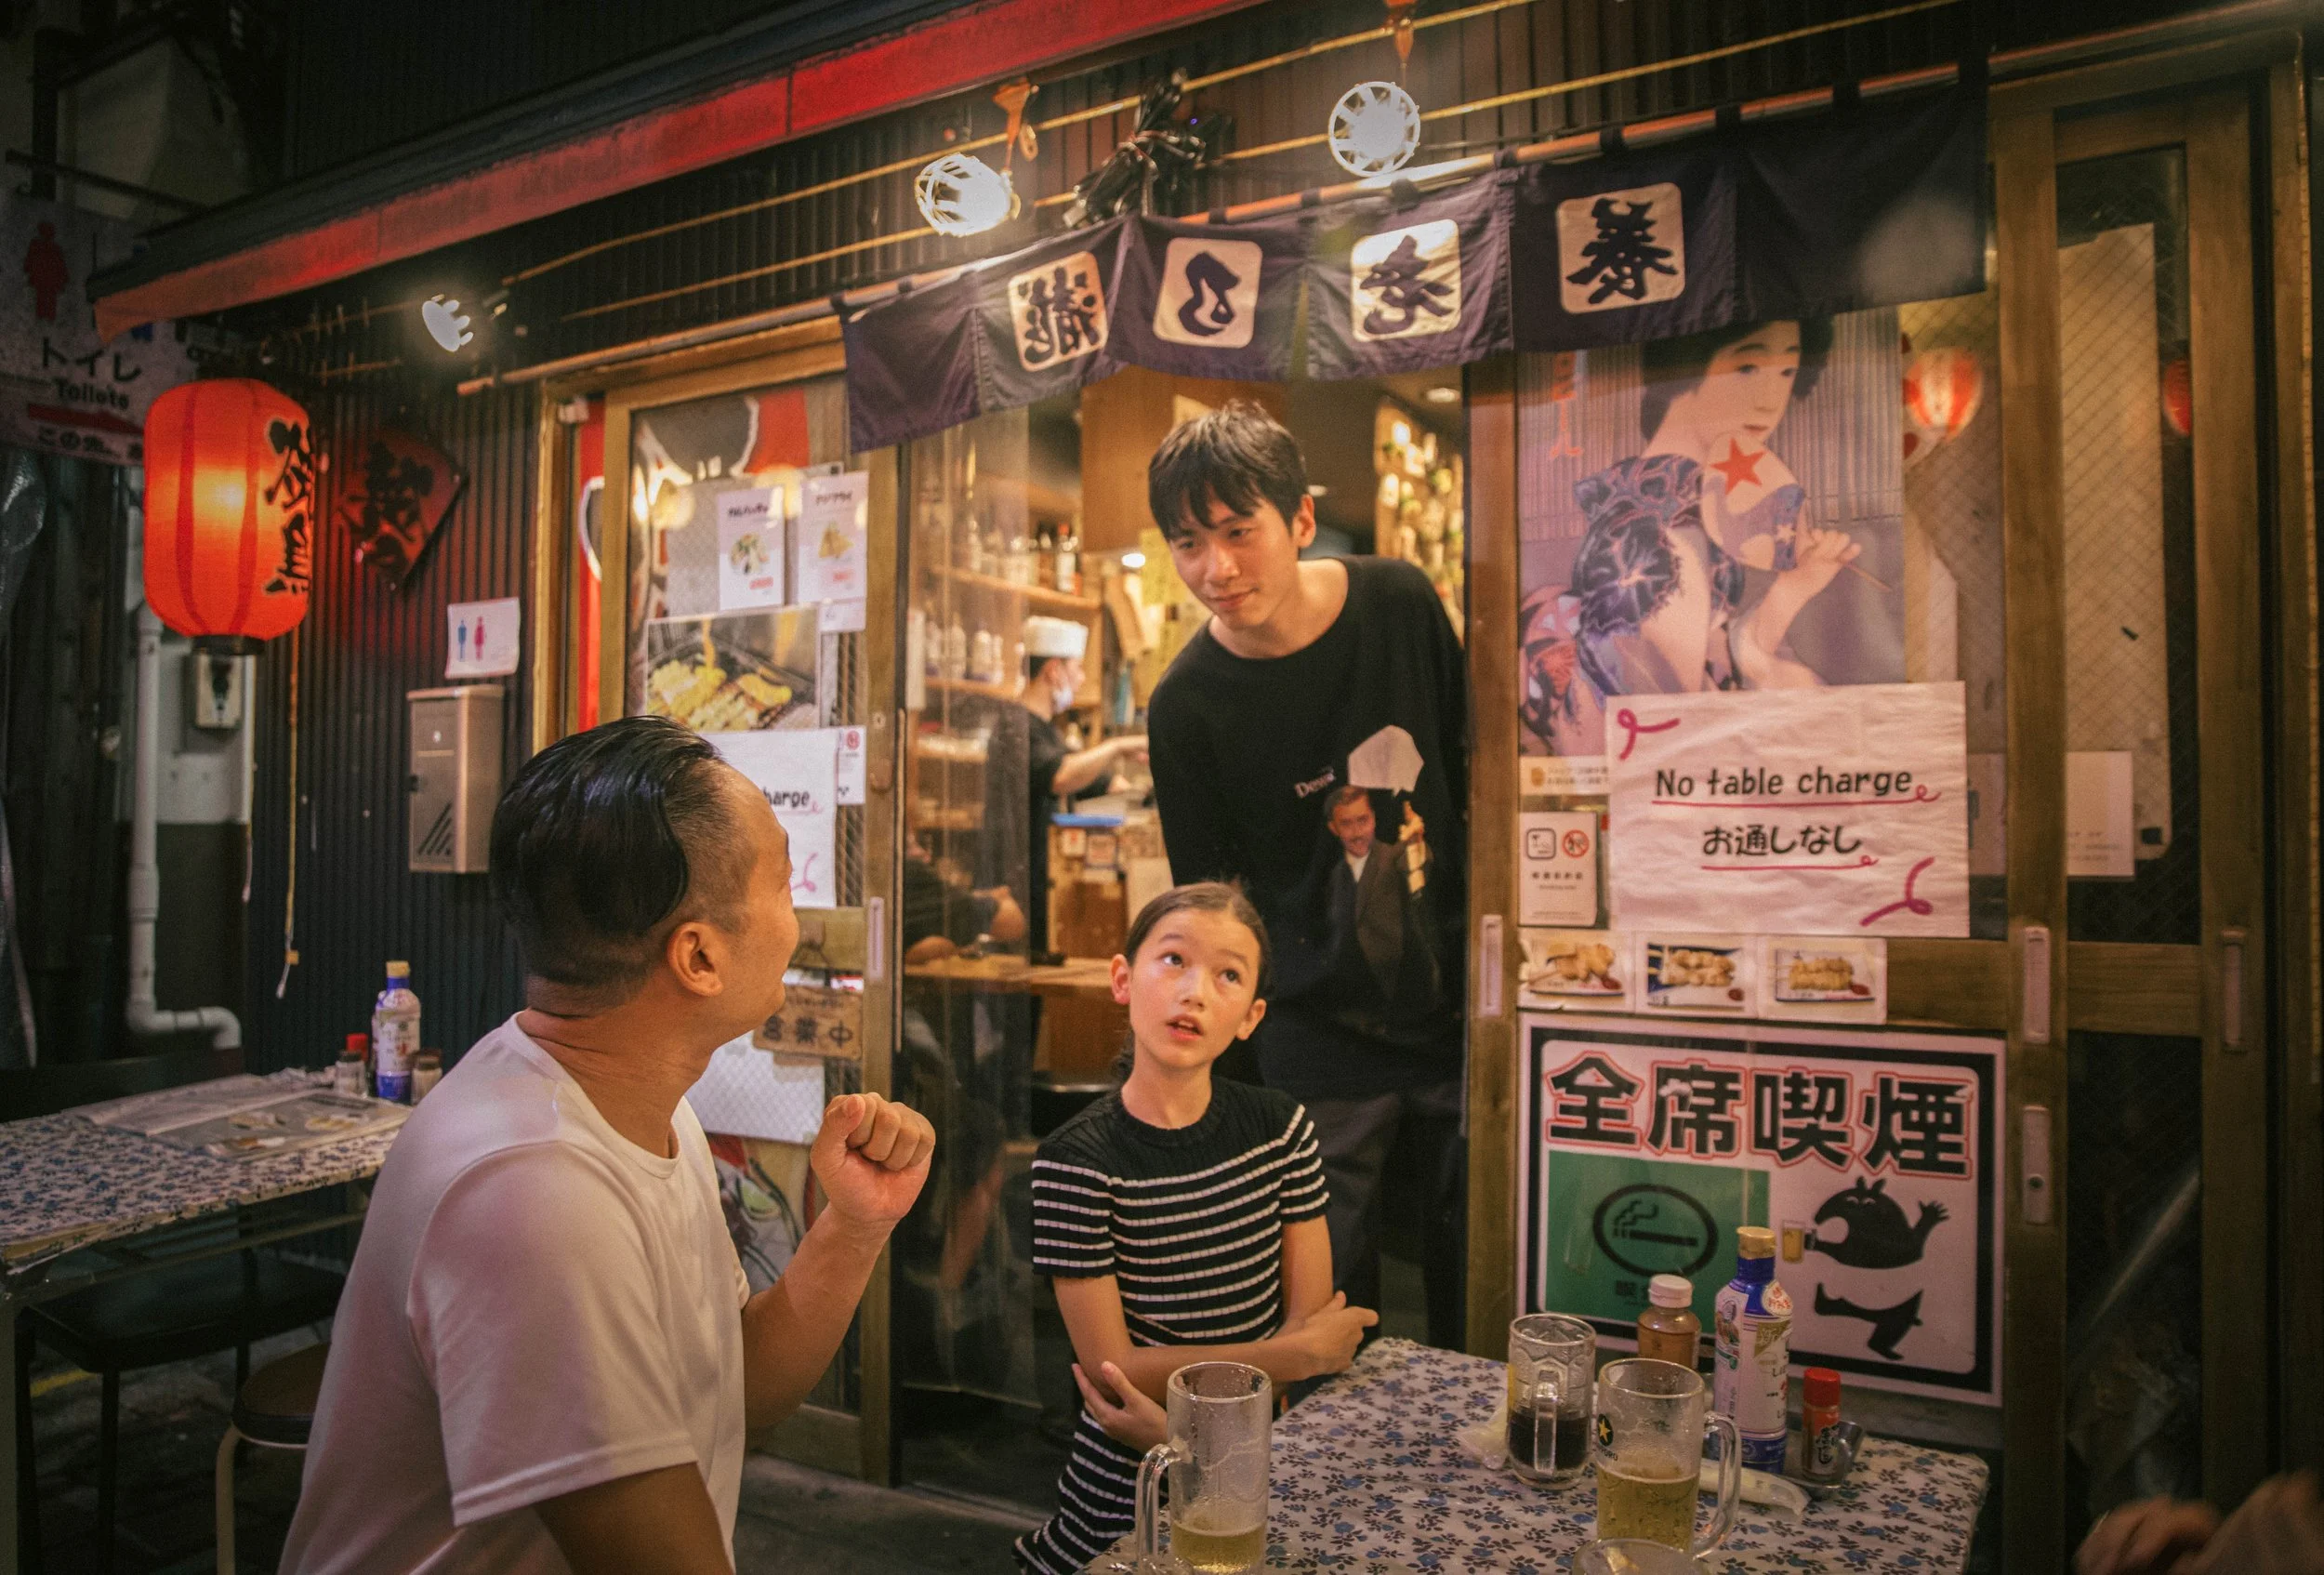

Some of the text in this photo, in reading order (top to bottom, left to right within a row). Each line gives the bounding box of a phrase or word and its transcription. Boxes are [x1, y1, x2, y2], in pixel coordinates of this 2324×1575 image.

[43, 337, 141, 383] トイレ
[55, 377, 130, 410] Toilets
[762, 786, 811, 809] harge
[1656, 766, 1913, 798] No table charge
[1702, 824, 1865, 857] お通しなし
[1545, 1051, 1974, 1181] 全席喫煙
